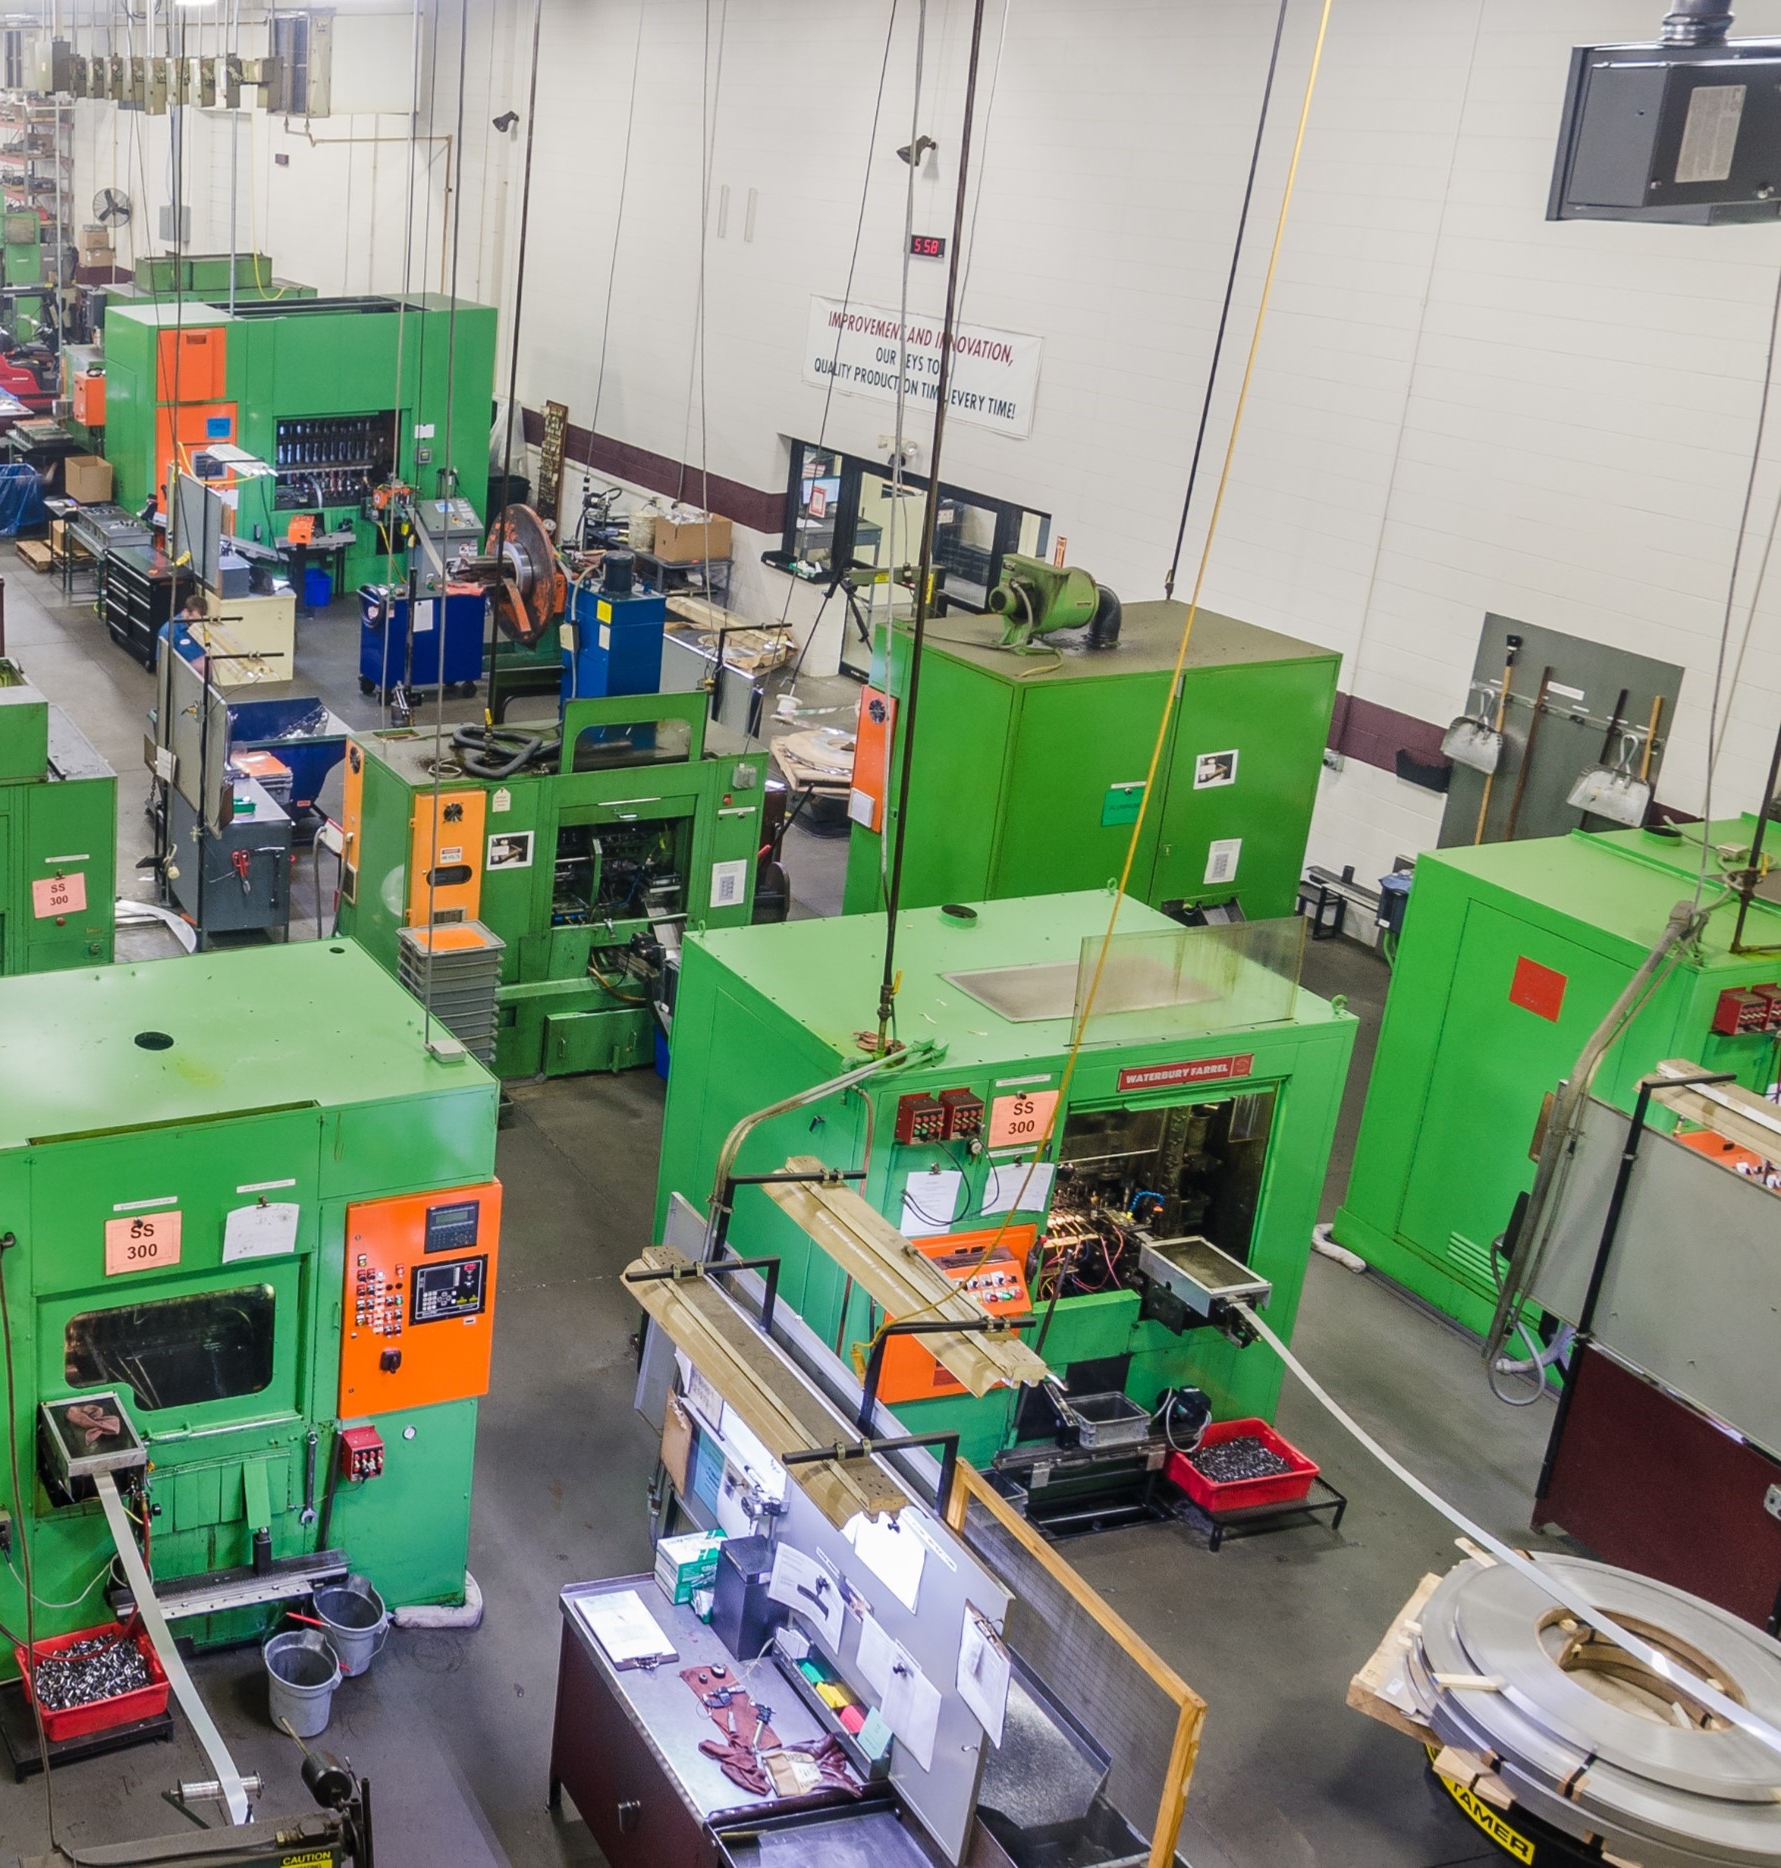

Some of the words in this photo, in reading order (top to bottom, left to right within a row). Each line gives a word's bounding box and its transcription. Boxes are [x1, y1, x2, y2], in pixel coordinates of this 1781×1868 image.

[828, 311, 907, 341] IMPROVEMEN
[906, 327, 933, 346] AND
[875, 347, 897, 366] OUR
[901, 353, 924, 372] EYS
[927, 357, 941, 375] TO
[814, 358, 852, 379] QUALITY
[904, 378, 919, 397] ON
[921, 381, 943, 402] TIM
[951, 389, 985, 412] EVERY
[988, 397, 1017, 420] TIME!
[51, 883, 66, 893] SS
[50, 895, 69, 906] 300
[1126, 1069, 1190, 1084] WATERBURY
[1190, 1064, 1228, 1076] FARREL
[1013, 1101, 1035, 1116] SS
[1008, 1119, 1035, 1135] 300
[130, 1223, 155, 1239] SS
[127, 1243, 158, 1260] 300
[282, 1850, 332, 1866] CAUTION
